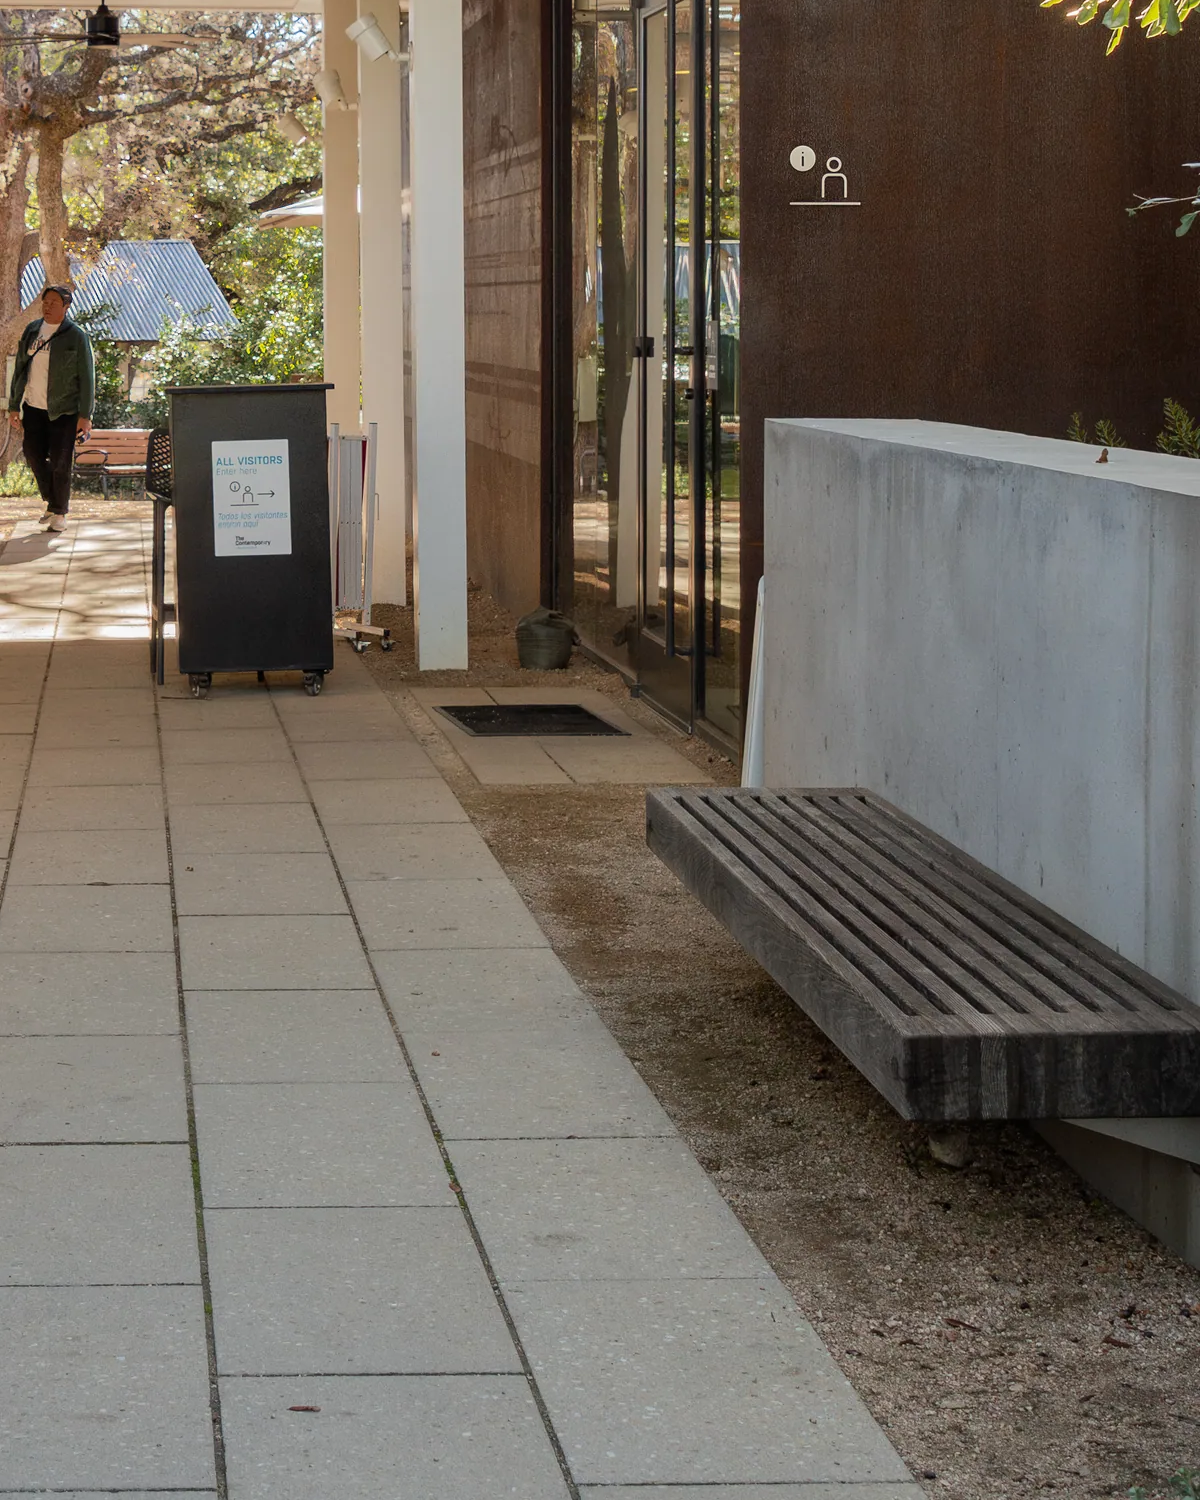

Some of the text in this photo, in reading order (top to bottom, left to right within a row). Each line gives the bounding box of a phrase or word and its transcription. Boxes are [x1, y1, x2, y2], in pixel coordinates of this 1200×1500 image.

[216, 456, 283, 466] ALL VISITORS
[216, 467, 258, 476] Enter here
[218, 512, 239, 520] Todos
[254, 511, 288, 519] visitantes
